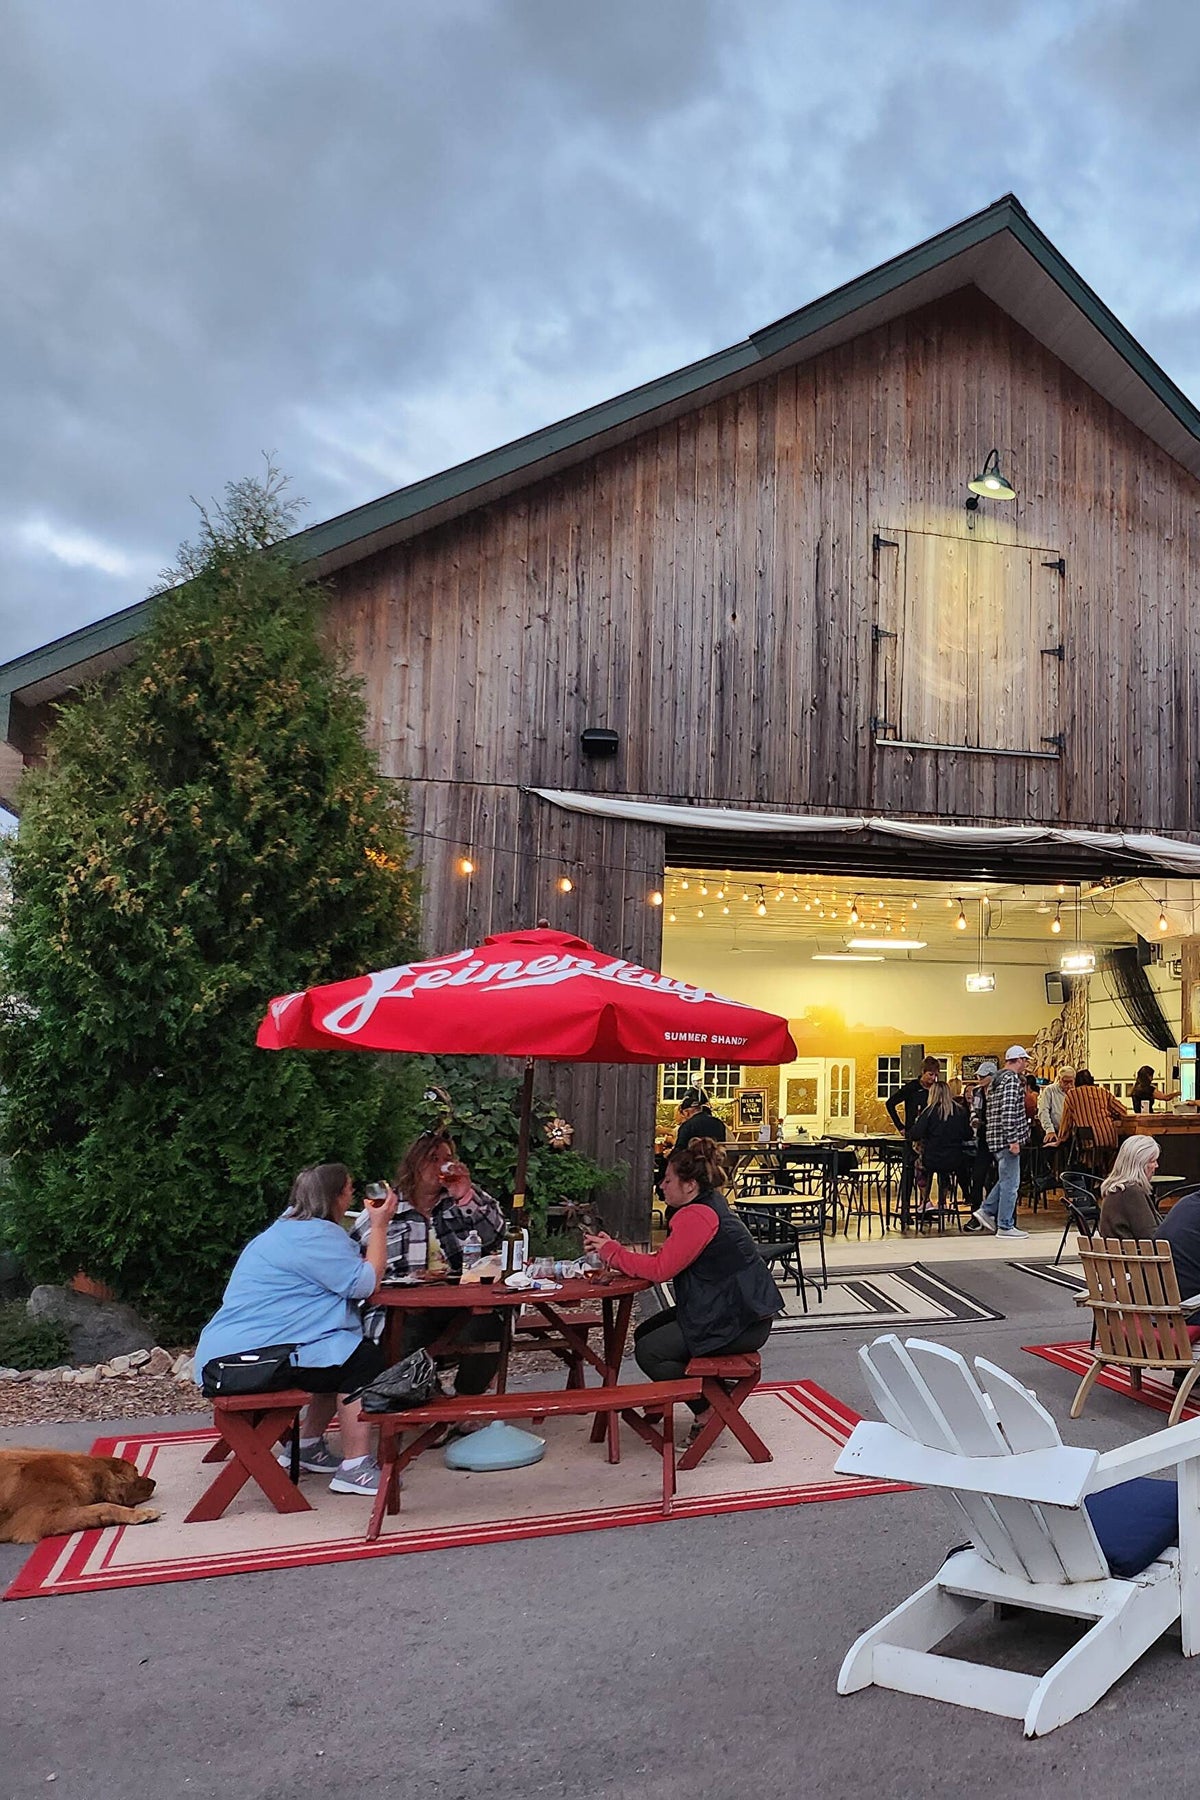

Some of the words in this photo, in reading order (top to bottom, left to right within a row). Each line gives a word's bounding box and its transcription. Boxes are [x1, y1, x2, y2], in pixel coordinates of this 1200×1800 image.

[664, 1031, 708, 1043] SUMMER
[710, 1034, 748, 1046] SHANDY
[354, 1472, 375, 1486] N
